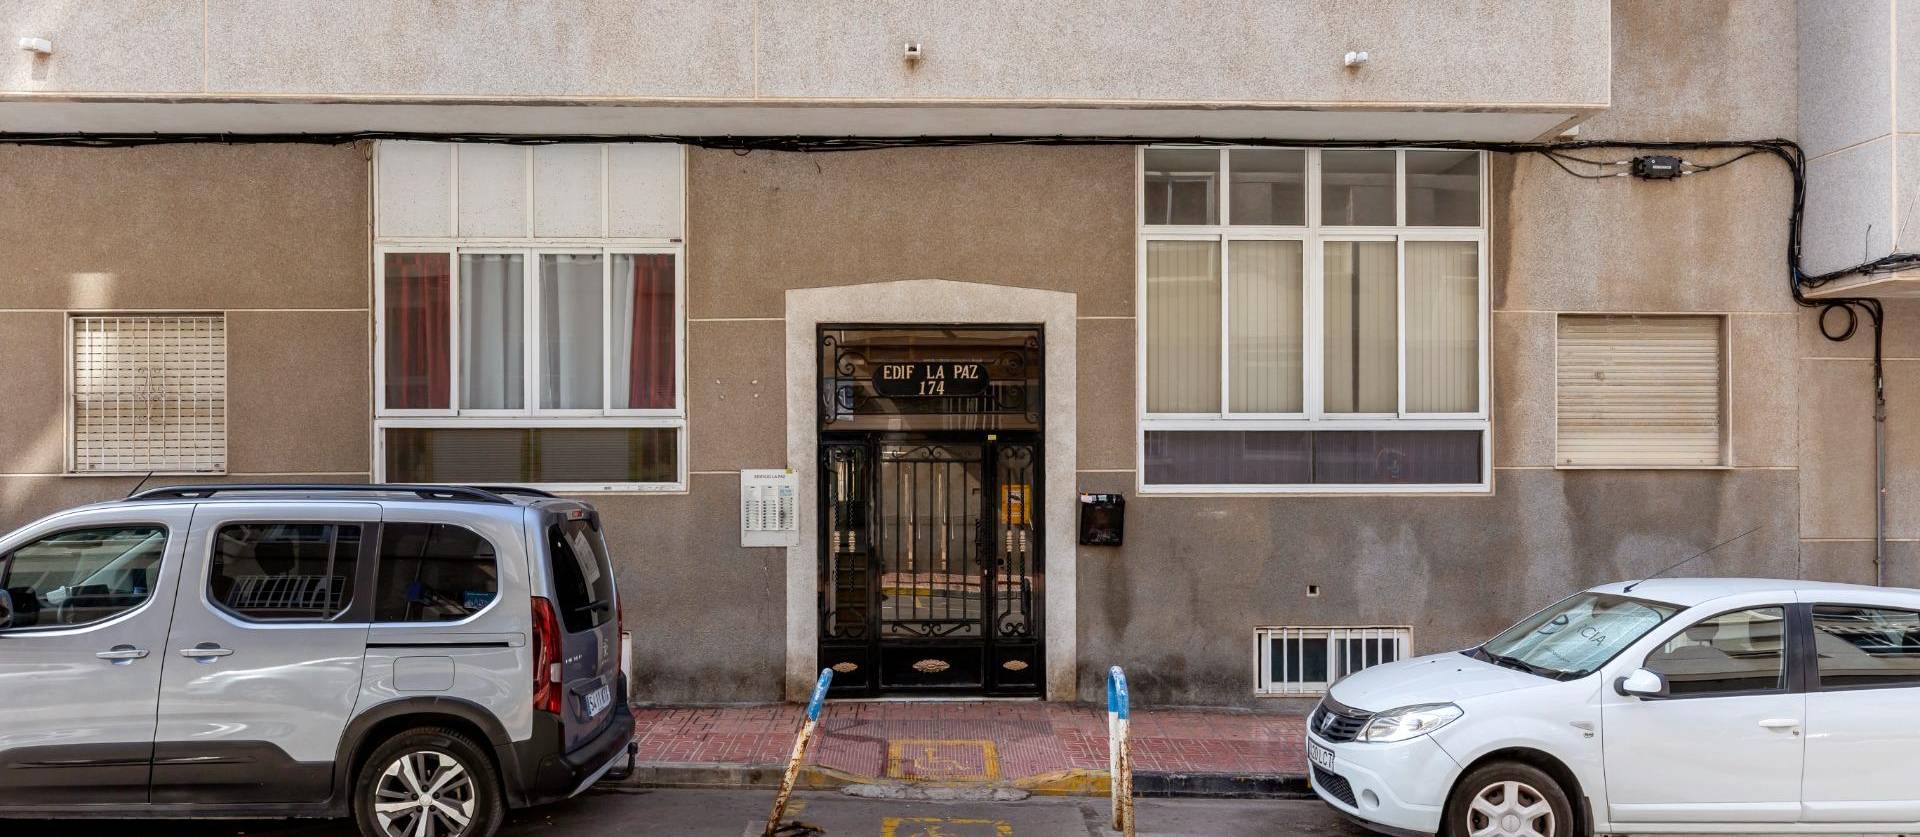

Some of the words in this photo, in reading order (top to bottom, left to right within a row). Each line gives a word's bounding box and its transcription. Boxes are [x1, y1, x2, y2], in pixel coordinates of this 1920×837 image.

[883, 365, 914, 379] EDIF
[926, 365, 944, 379] LA
[954, 365, 978, 379] PAZ
[919, 381, 944, 395] 174
